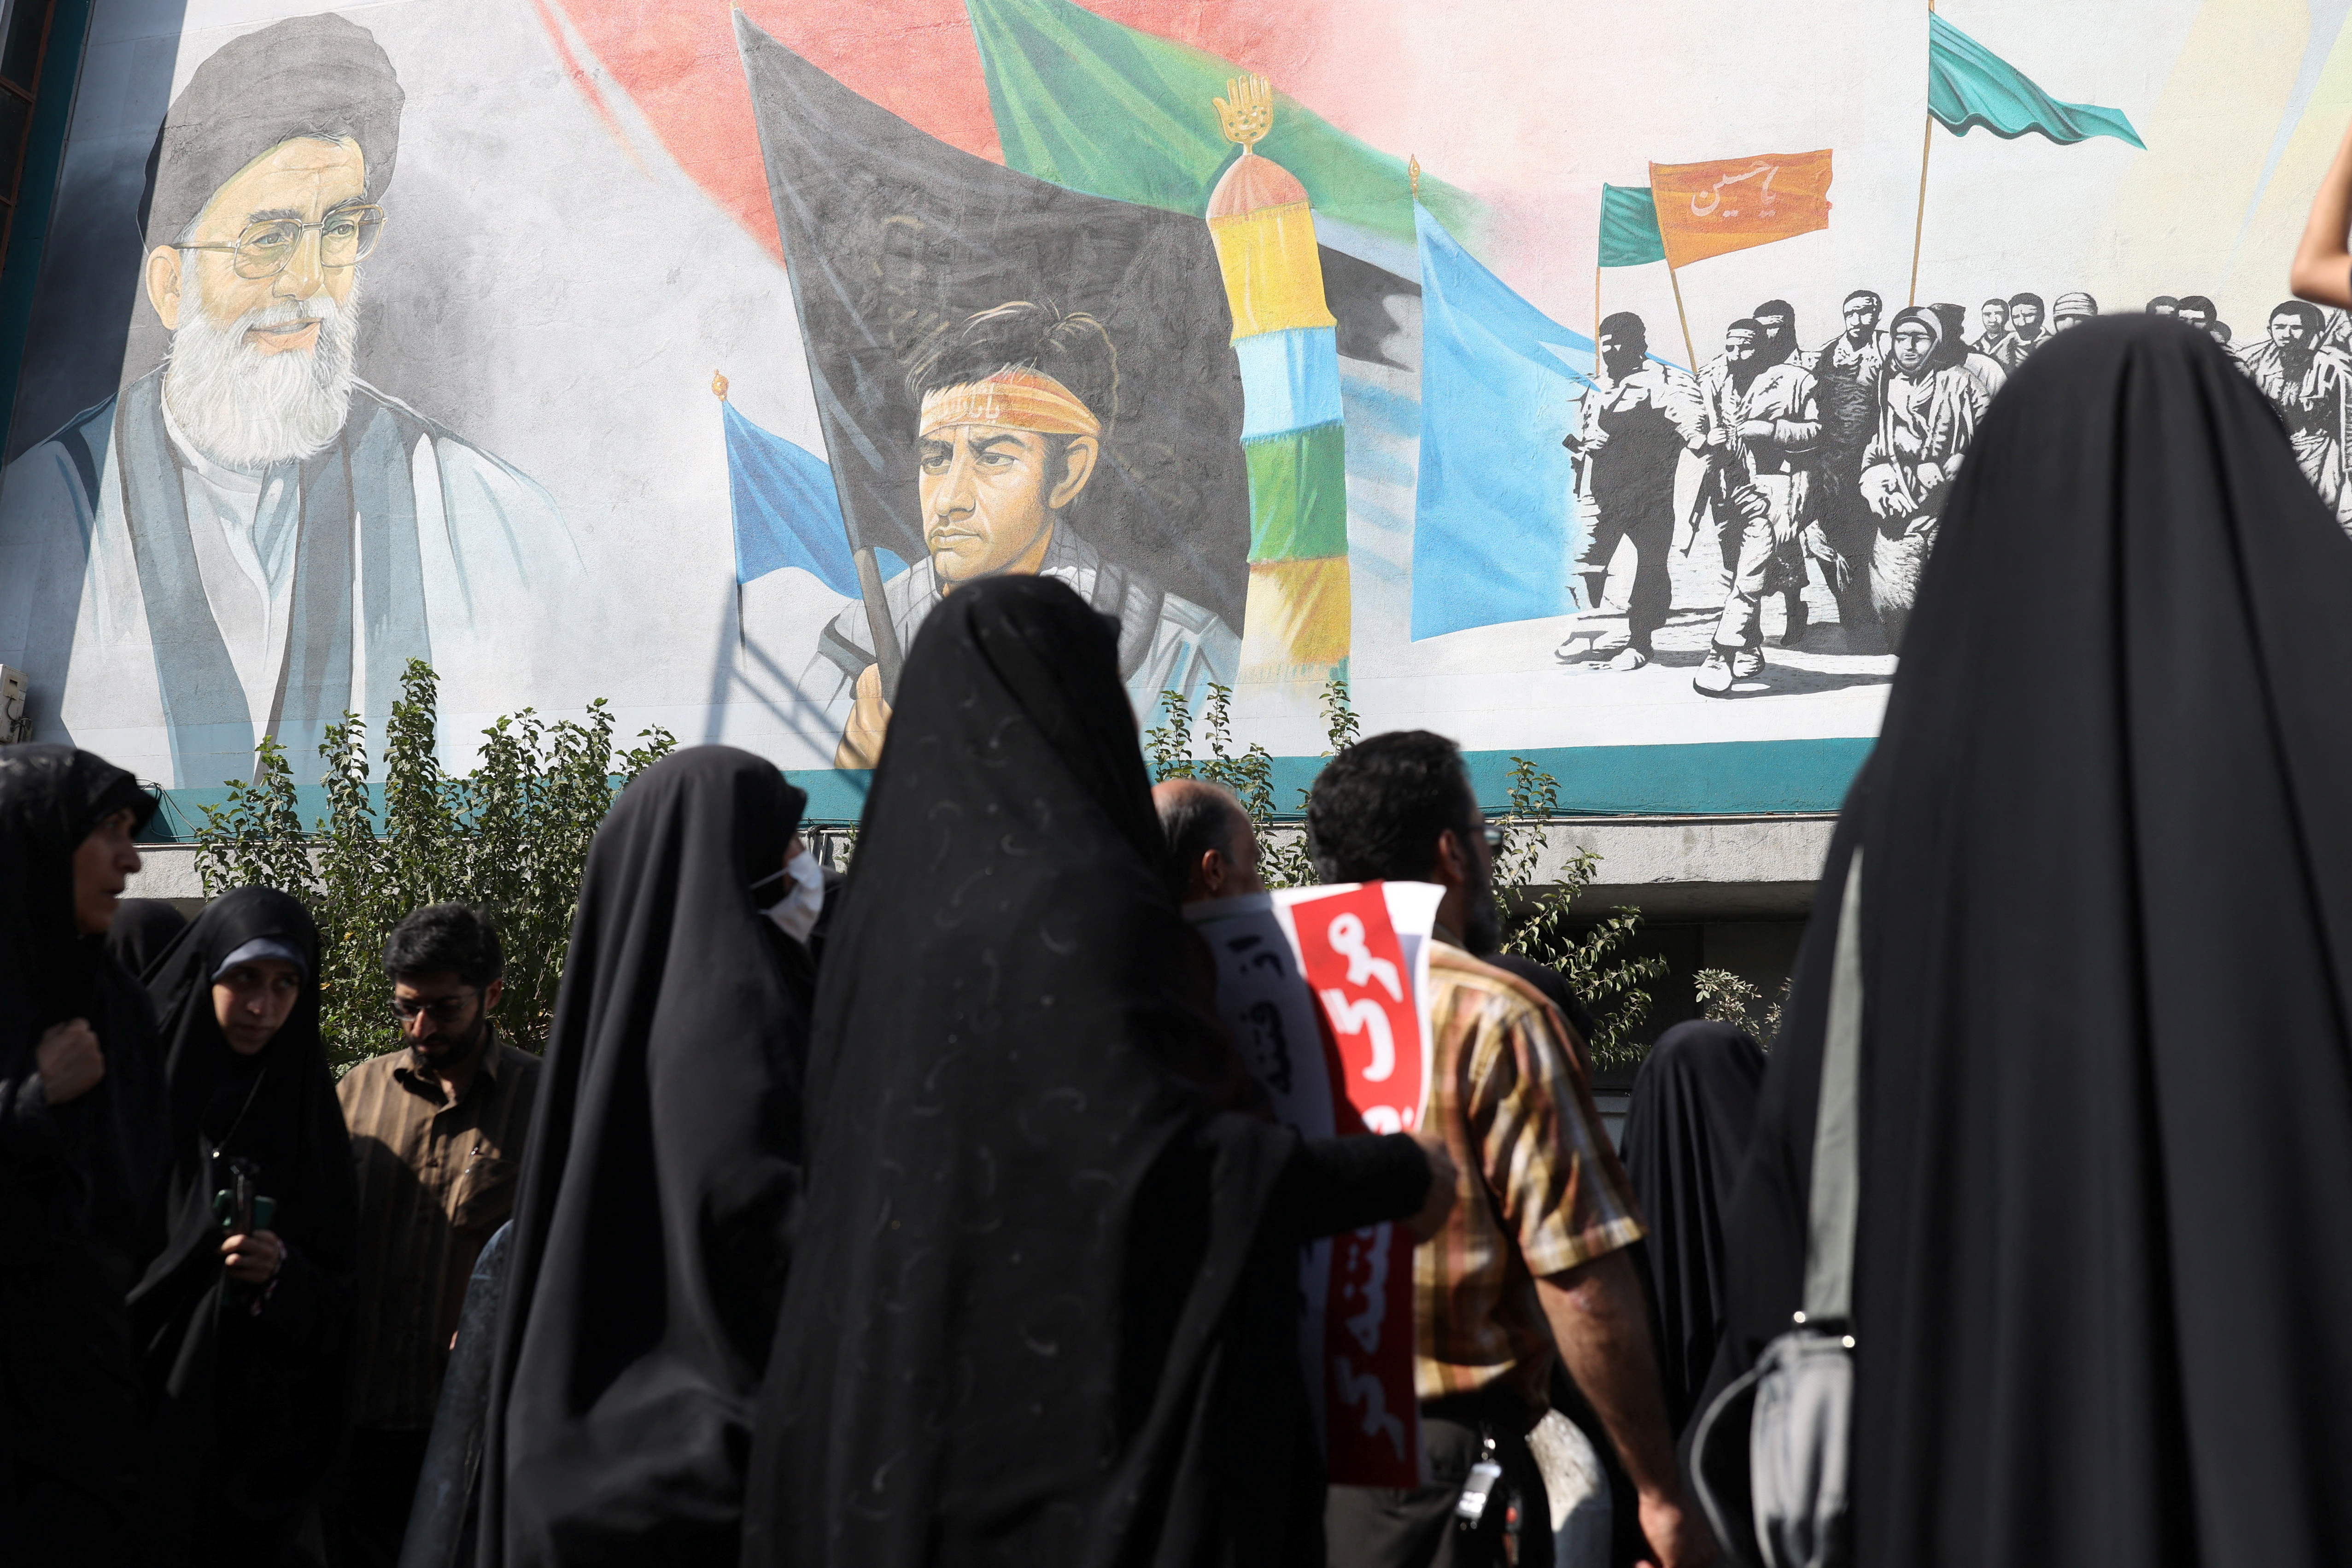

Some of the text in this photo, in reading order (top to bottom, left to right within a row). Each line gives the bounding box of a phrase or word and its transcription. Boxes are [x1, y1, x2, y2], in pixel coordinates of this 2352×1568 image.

[1691, 160, 1780, 217] یا حسین
[985, 382, 1000, 424] یا
[1226, 936, 1284, 977] از
[1320, 913, 1403, 1082] مرگ
